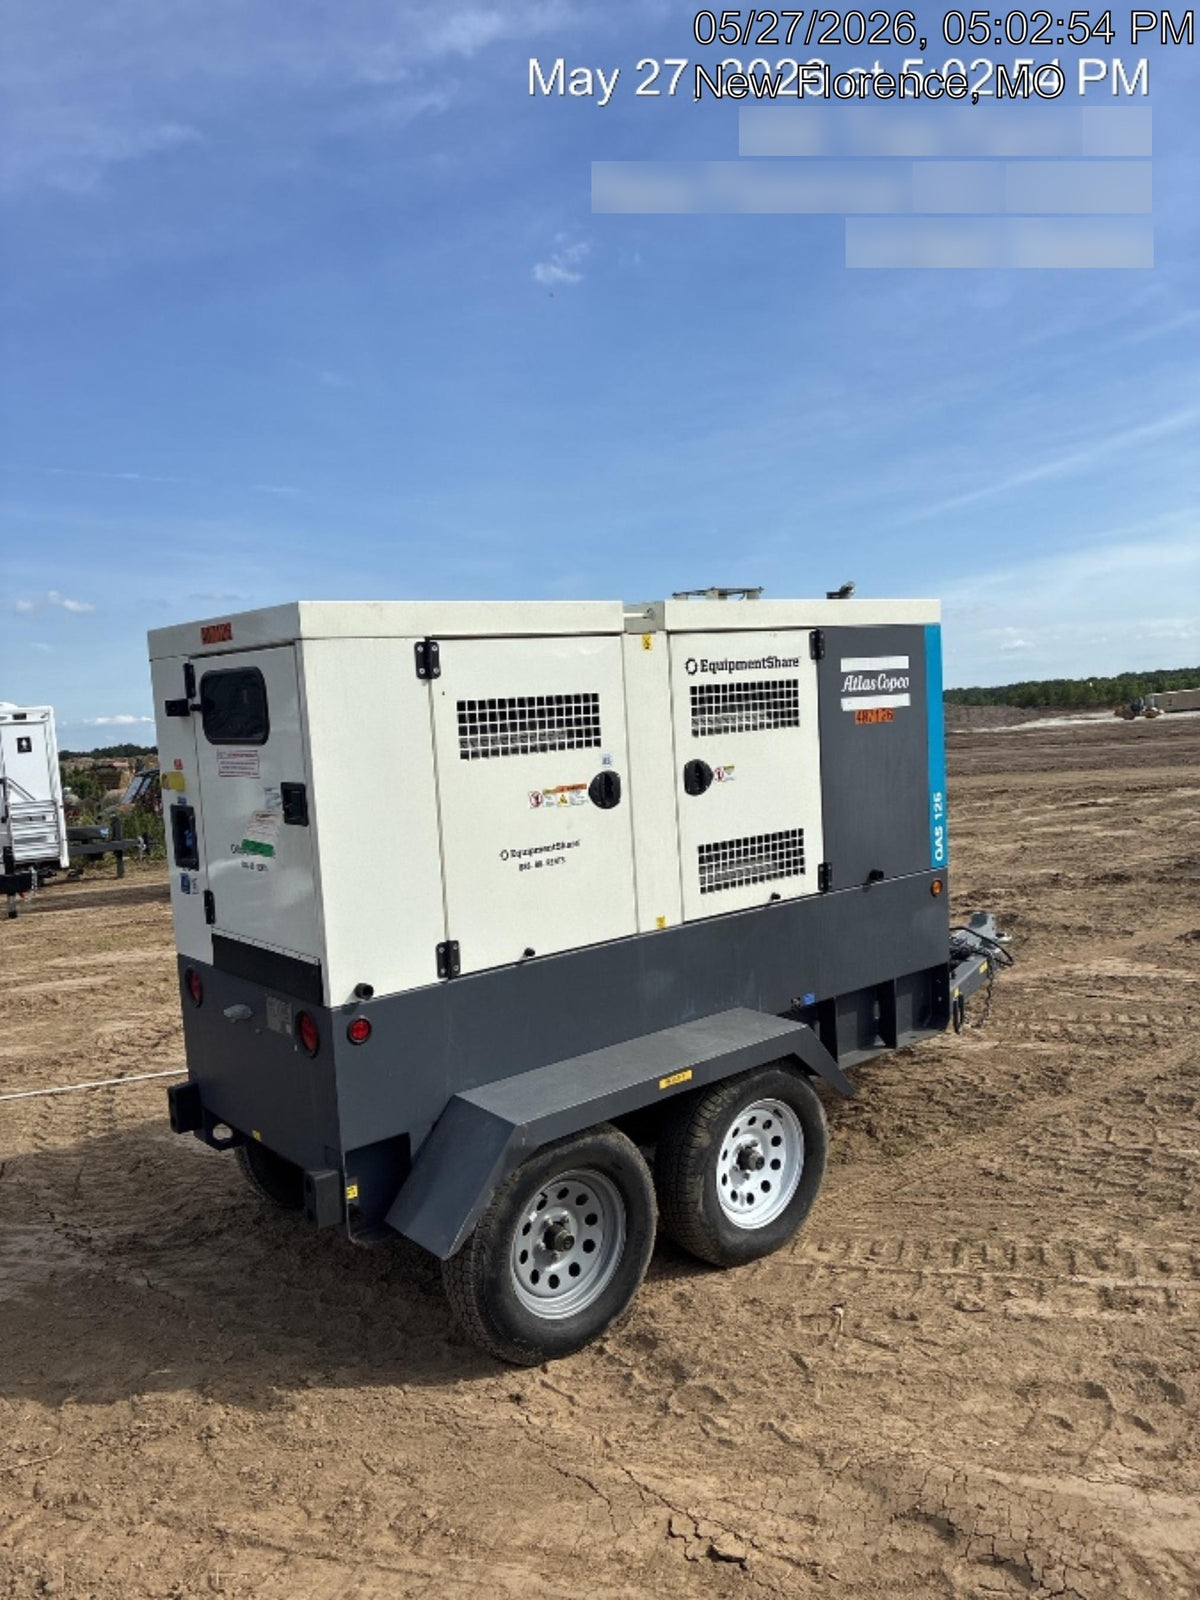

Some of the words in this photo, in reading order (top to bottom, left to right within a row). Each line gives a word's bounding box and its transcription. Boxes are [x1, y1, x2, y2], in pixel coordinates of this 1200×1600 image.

[700, 655, 799, 675] EquipmentShare
[840, 674, 876, 692] Atlas
[877, 673, 909, 692] Copco
